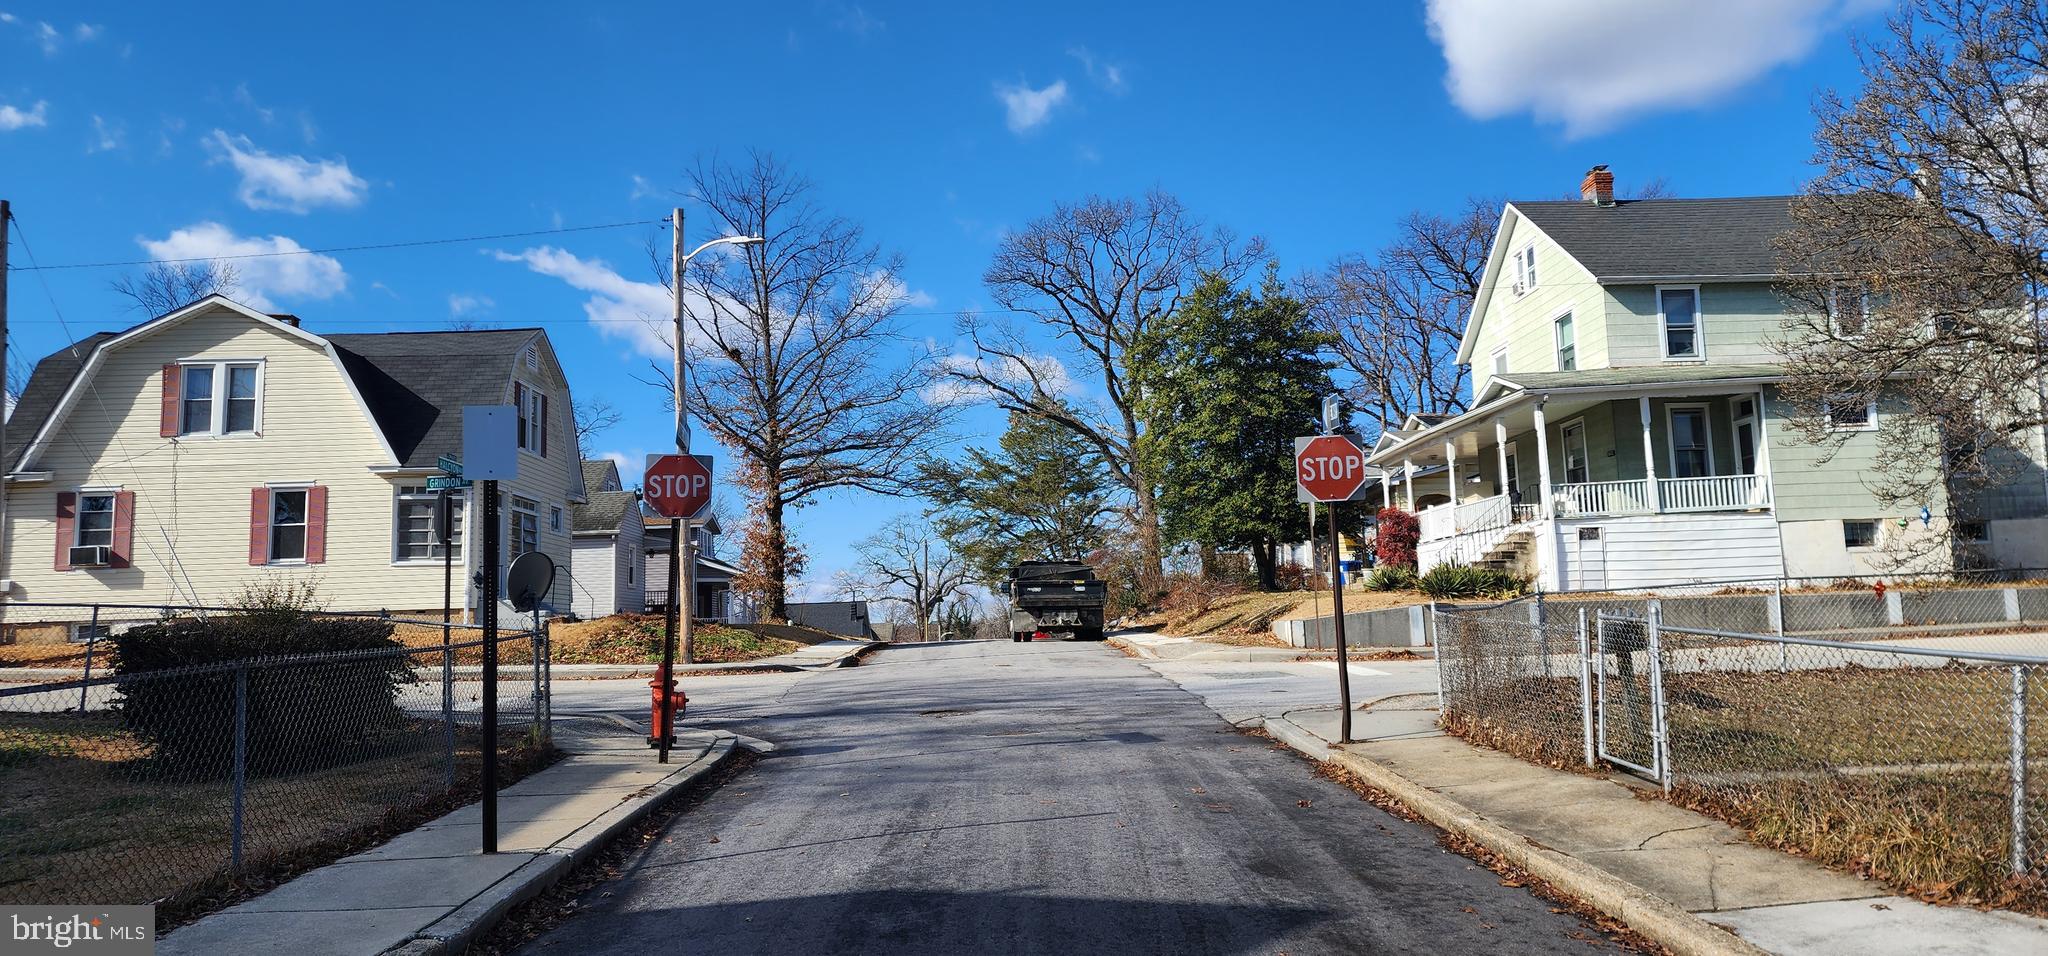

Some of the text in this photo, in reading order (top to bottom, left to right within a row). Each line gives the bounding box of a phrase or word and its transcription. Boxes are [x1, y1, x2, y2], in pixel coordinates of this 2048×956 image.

[1302, 455, 1360, 481] STOP
[429, 478, 460, 488] GRINDON
[648, 474, 706, 498] STOP
